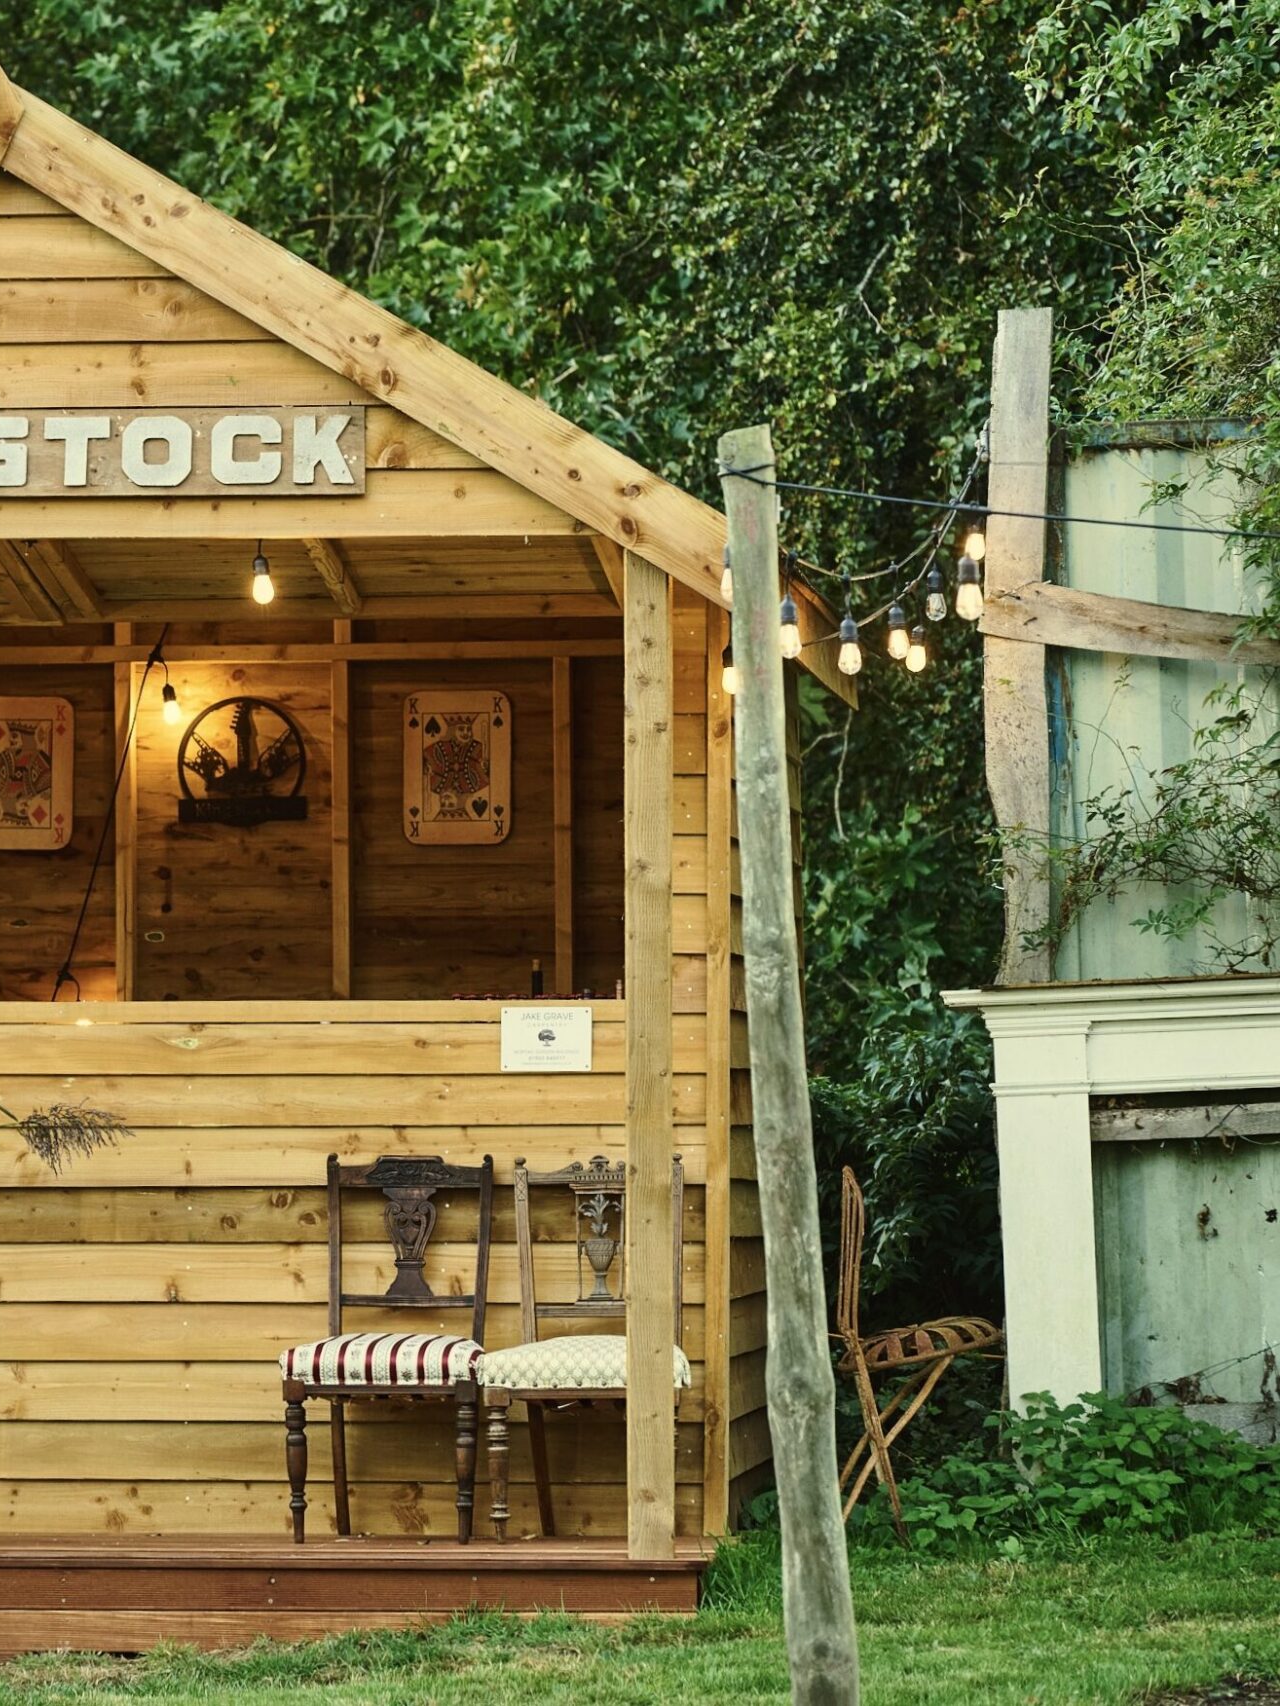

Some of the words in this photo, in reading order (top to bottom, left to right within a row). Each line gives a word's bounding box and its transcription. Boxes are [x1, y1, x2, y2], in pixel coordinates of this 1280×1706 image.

[56, 705, 66, 721] K
[409, 698, 419, 714] K
[493, 697, 503, 713] K
[55, 828, 64, 843] K
[410, 821, 419, 837] K
[494, 820, 504, 836] K
[521, 1012, 541, 1021] JAKE
[543, 1012, 574, 1021] GRAVE
